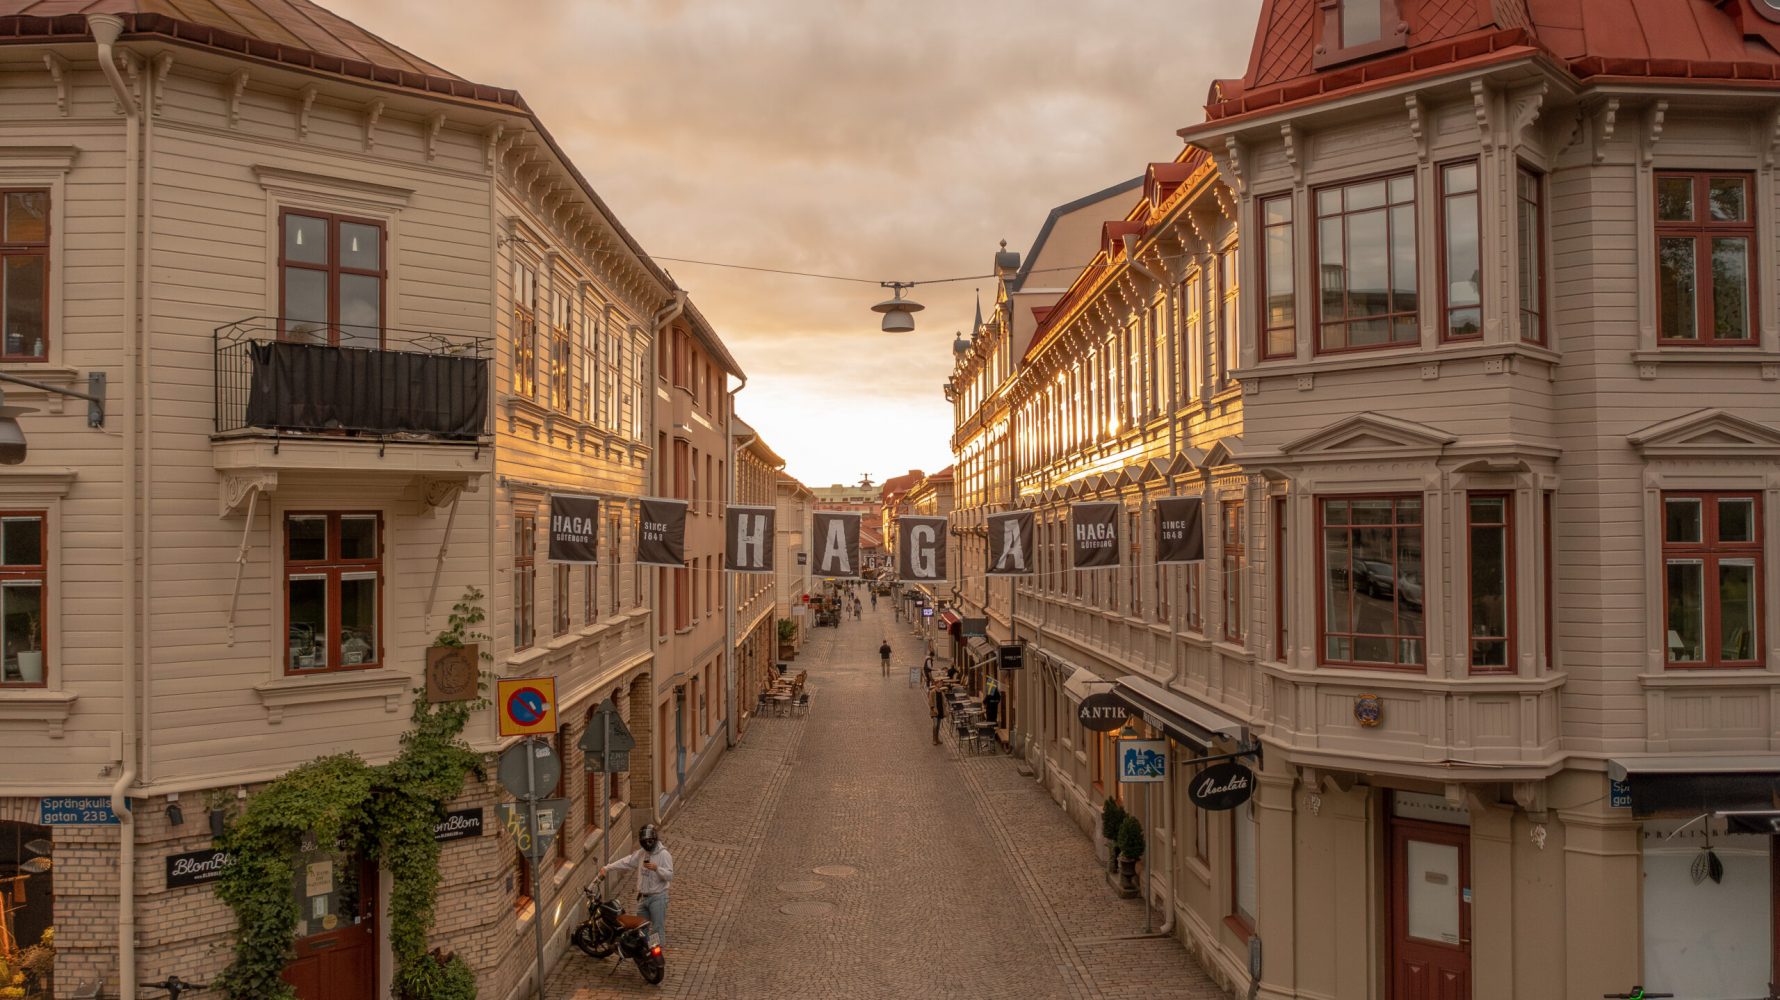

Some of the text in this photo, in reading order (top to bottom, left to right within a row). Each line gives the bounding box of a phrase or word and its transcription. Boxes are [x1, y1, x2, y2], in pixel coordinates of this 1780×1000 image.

[553, 515, 593, 535] HAGA
[644, 521, 668, 532] SINCE
[1076, 523, 1116, 541] HAGA
[1162, 521, 1186, 530] SINCE
[736, 513, 766, 568] H
[996, 519, 1025, 570] A
[1163, 531, 1183, 540] 1648
[820, 519, 851, 572] A
[910, 524, 937, 578] G
[1080, 706, 1127, 719] ANTIK
[1196, 774, 1248, 799] Chocolate
[43, 797, 112, 811] Sprängkulls
[44, 812, 78, 824] gatan
[433, 815, 480, 833] omBlom
[172, 852, 237, 876] BlomBlo
